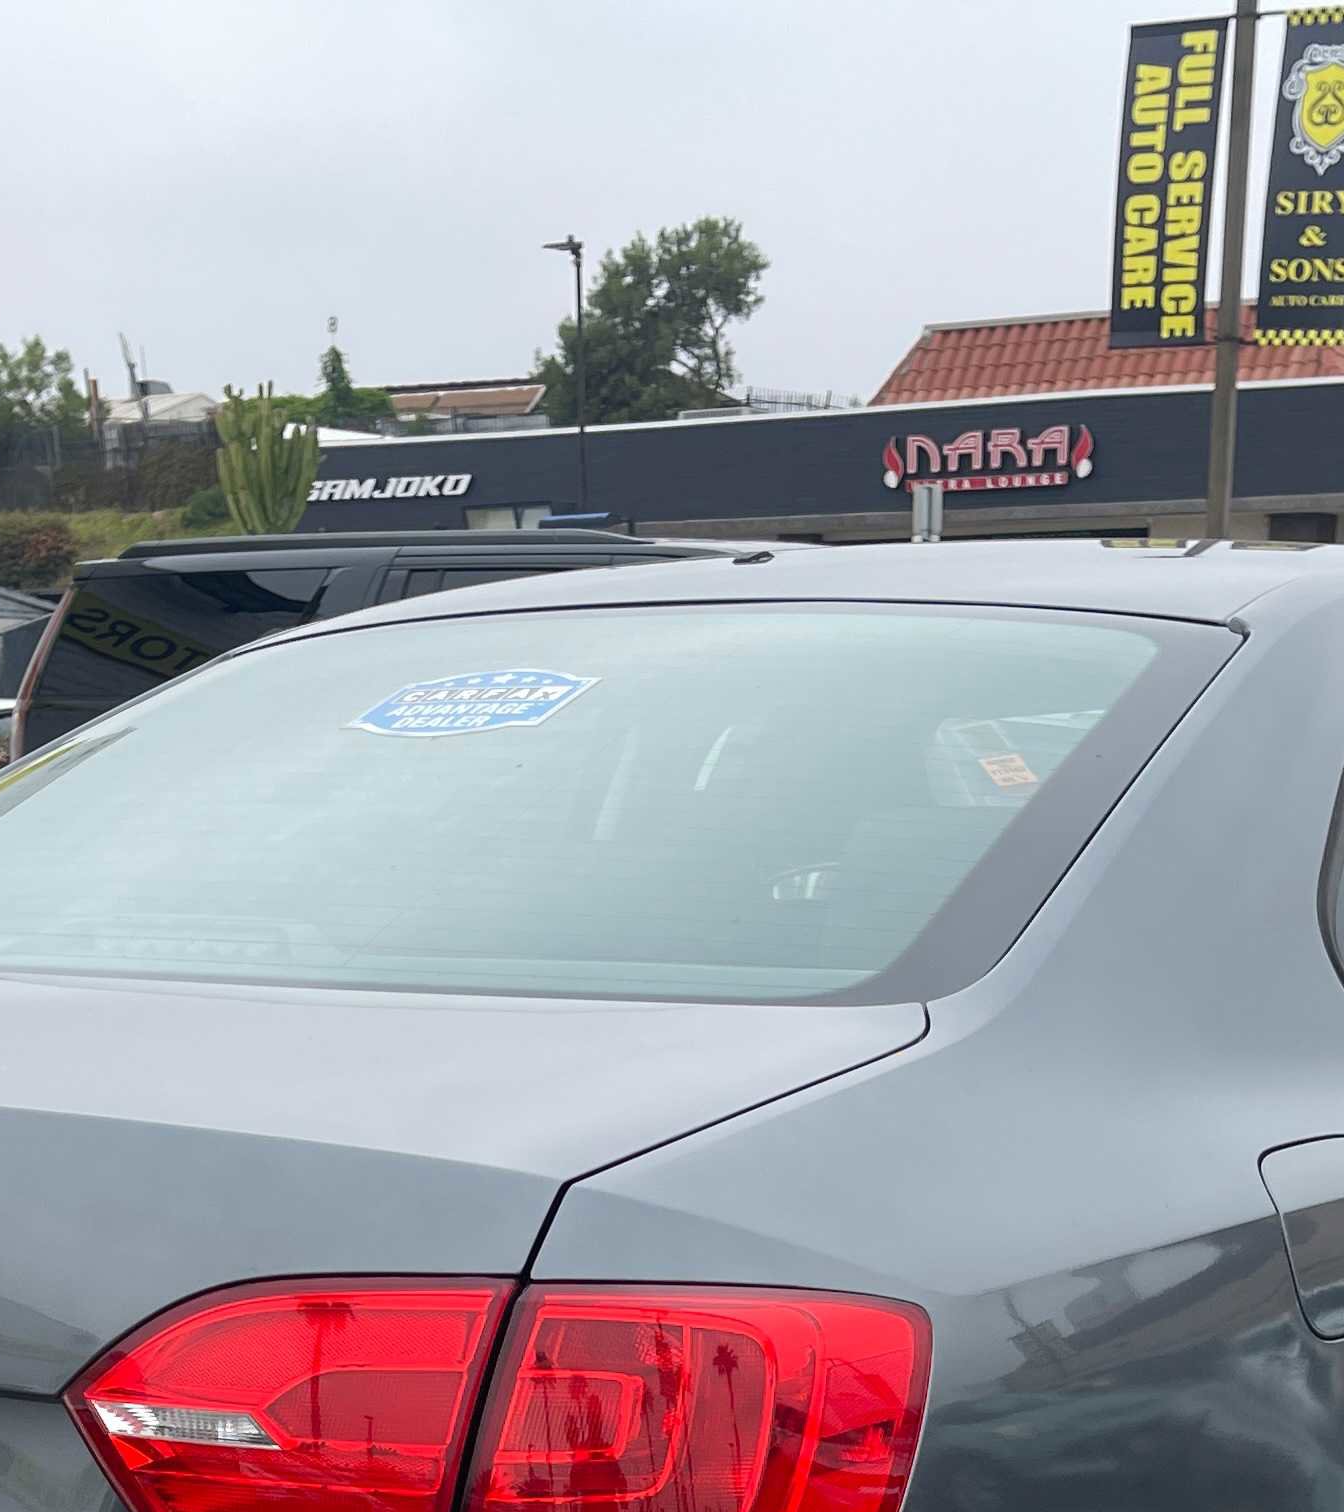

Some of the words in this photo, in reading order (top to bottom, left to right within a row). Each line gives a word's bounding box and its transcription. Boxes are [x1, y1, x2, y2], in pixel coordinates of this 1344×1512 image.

[1172, 29, 1219, 132] FULL
[1126, 63, 1173, 184] AUTO
[1159, 150, 1207, 338] SERVICE
[1298, 225, 1327, 247] &
[1120, 193, 1161, 310] CARE
[906, 425, 1070, 474] NARA
[306, 474, 472, 502] SAMJOKO
[986, 472, 1064, 489] LOUNGE
[398, 685, 573, 702] CARFAX
[385, 701, 534, 718] ADVANTAGE
[390, 714, 492, 729] DEALER
